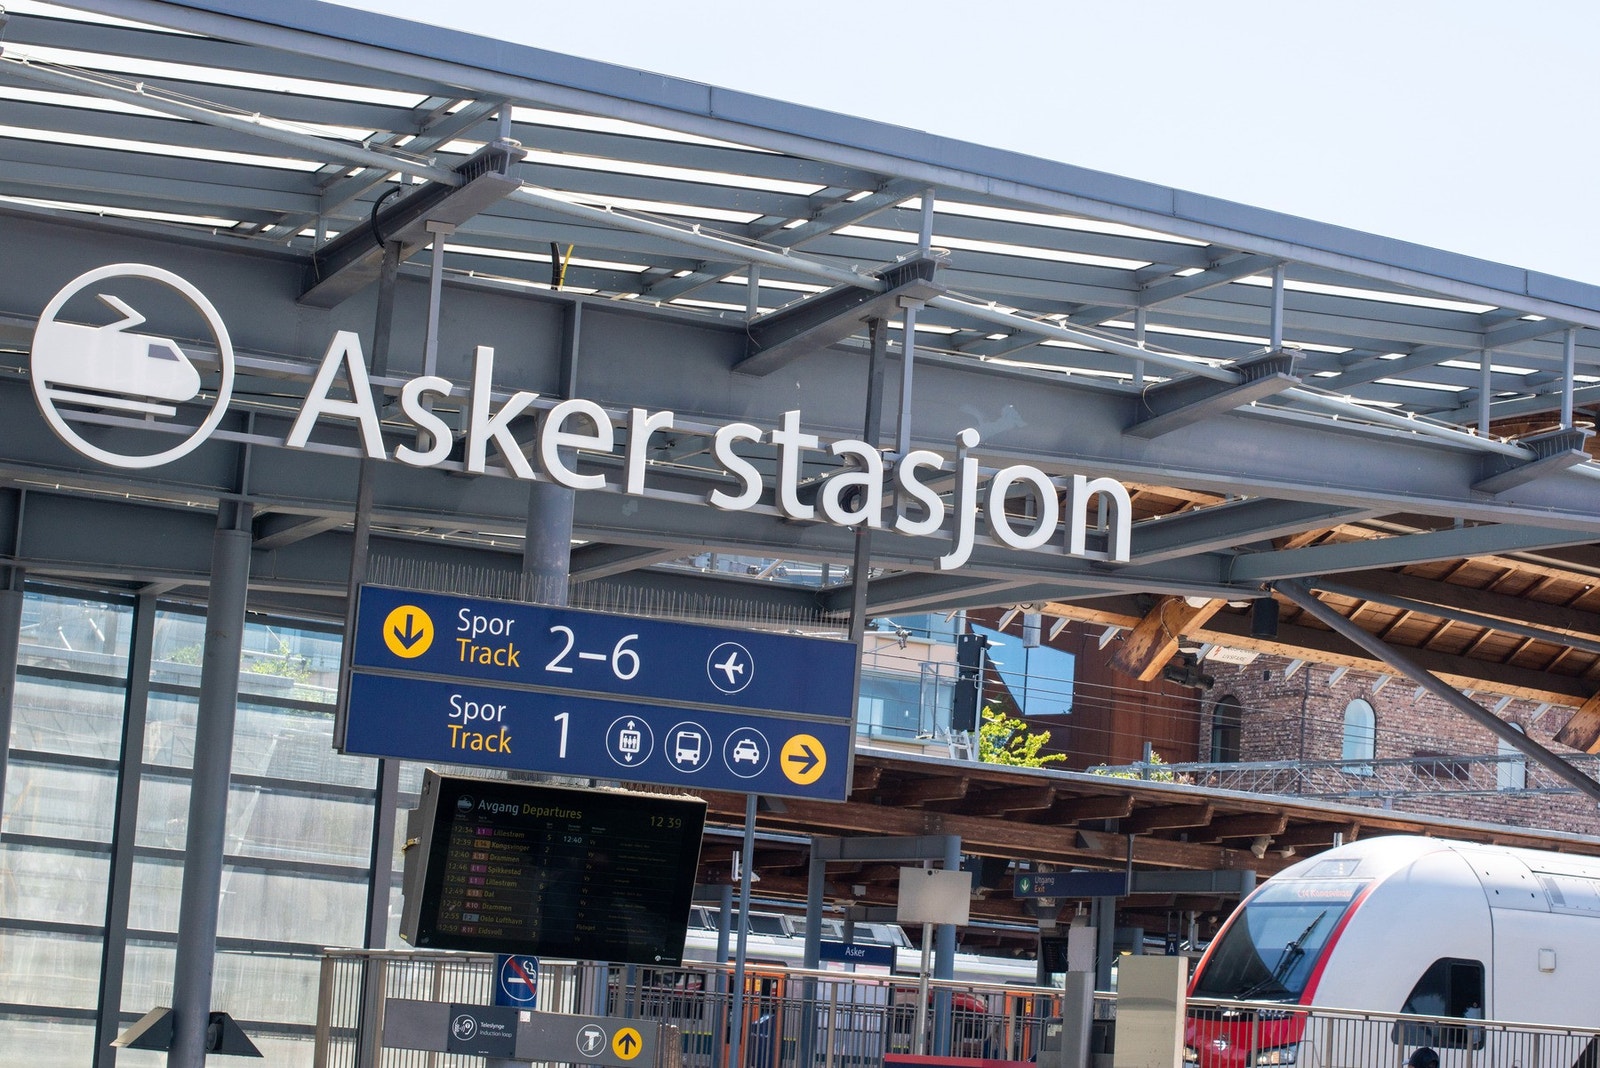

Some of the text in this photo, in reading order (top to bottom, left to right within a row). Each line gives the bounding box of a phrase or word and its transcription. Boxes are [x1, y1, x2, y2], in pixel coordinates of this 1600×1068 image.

[286, 330, 1133, 571] Asker stasjon
[456, 607, 515, 637] Spor
[456, 637, 520, 668] Track
[448, 693, 507, 724] Spor
[448, 724, 512, 754] Track
[553, 712, 570, 759] 1
[478, 799, 582, 820] Avgang Departures
[452, 837, 472, 847] 12:39
[563, 835, 583, 844] 12:40
[489, 853, 520, 863] Drammen
[487, 866, 522, 876] Spikkestad
[1034, 876, 1055, 886] Utgang
[483, 890, 495, 898] Dal
[1034, 885, 1046, 893] Exit
[482, 902, 512, 912] Drammen
[845, 947, 865, 957] Asker
[480, 1022, 505, 1030] Teleslynge
[479, 1030, 513, 1039] Induction loop
